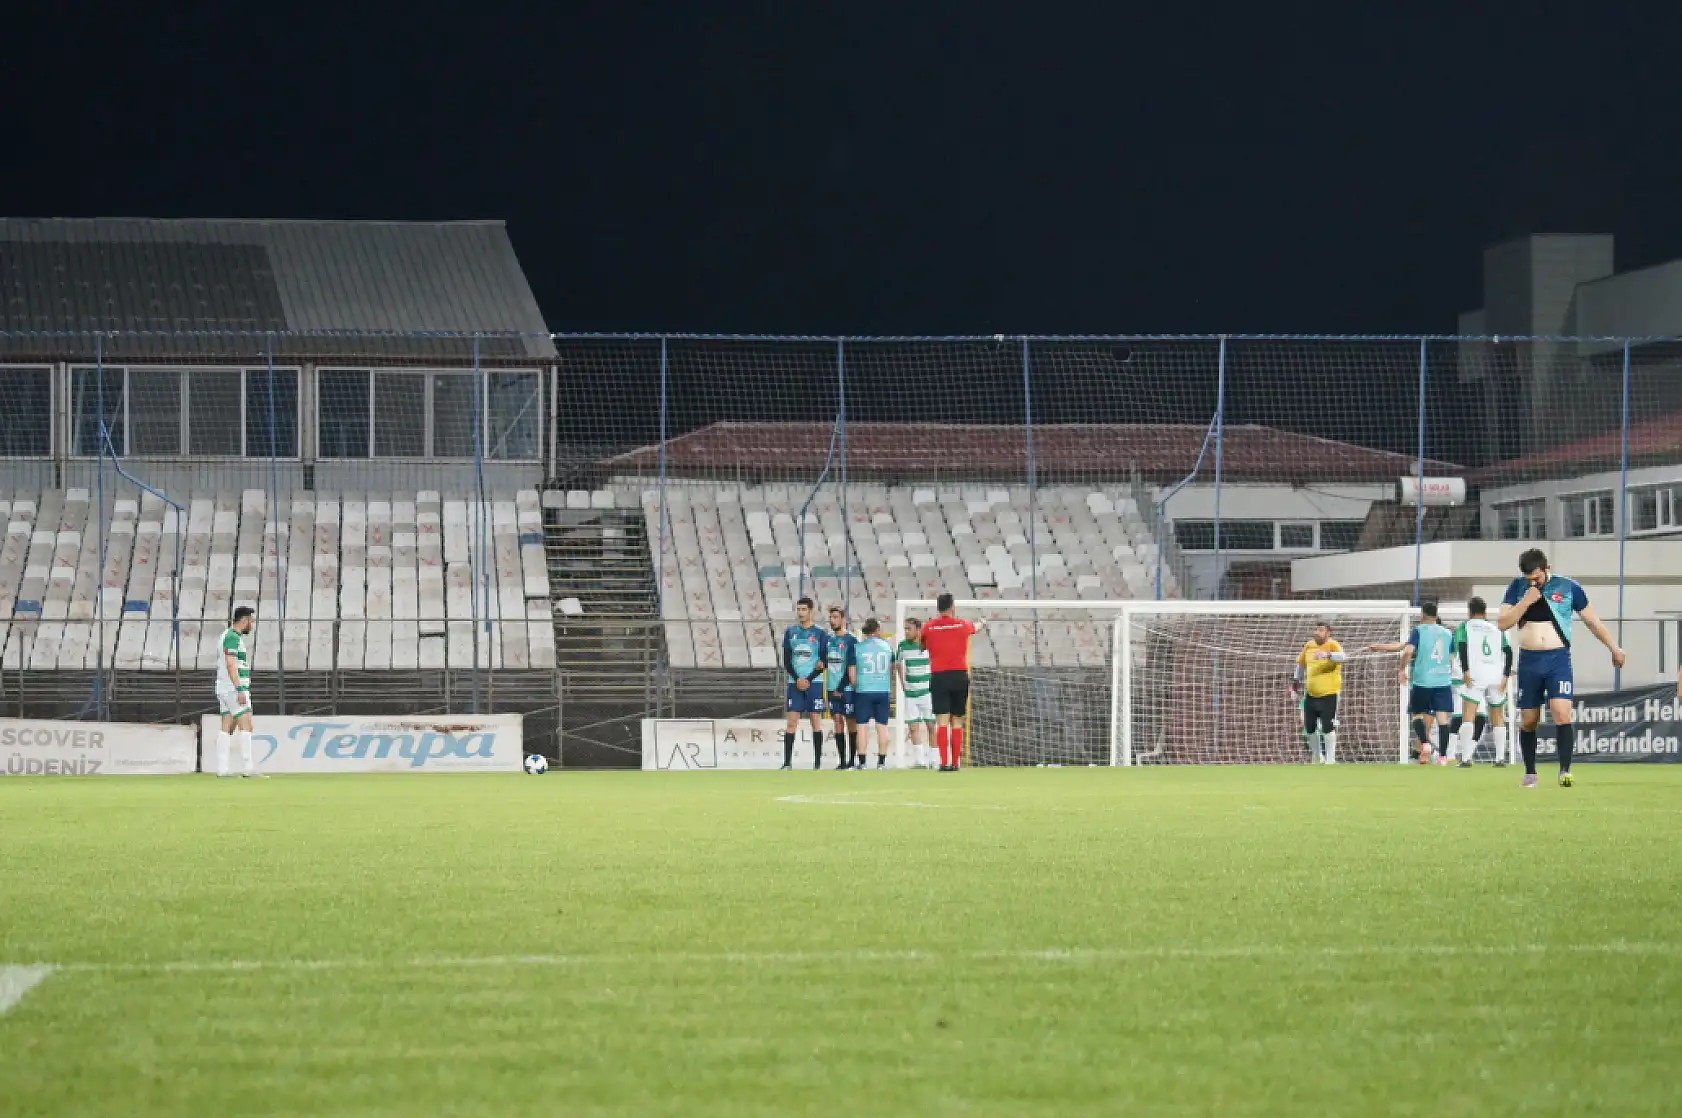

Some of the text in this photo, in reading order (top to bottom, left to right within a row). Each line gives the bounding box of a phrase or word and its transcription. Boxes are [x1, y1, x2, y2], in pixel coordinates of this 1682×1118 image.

[1431, 640, 1443, 665] 4
[1482, 635, 1492, 656] 6
[861, 651, 889, 674] 30
[1558, 680, 1572, 694] 10
[1, 728, 105, 749] SCOVER
[287, 722, 497, 768] Tempa
